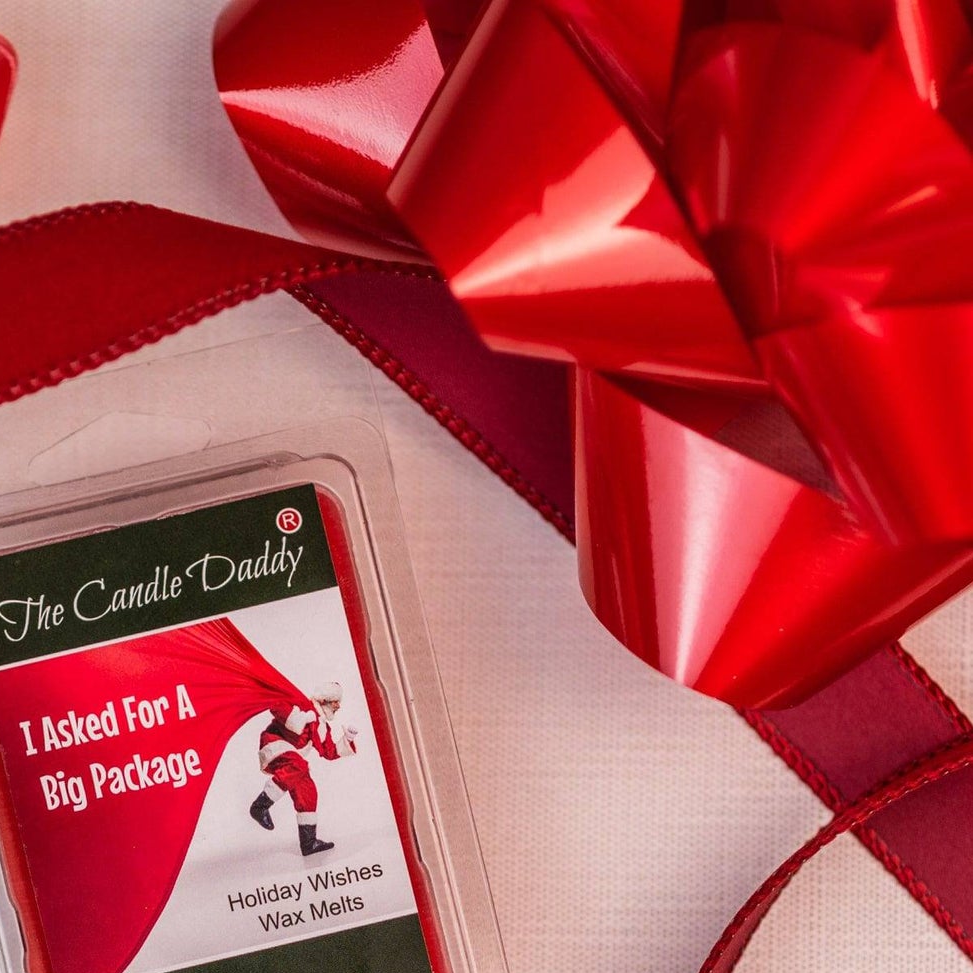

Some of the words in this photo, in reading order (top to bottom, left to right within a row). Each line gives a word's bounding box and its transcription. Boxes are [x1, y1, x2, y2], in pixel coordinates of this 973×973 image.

[73, 565, 182, 621] Candle
[185, 536, 304, 592] Daddy
[19, 719, 38, 756] I
[42, 708, 120, 752] Asked
[123, 694, 171, 734] For
[176, 684, 197, 721] A
[39, 771, 87, 812] Big
[92, 748, 203, 800] Package
[227, 881, 304, 911] Holiday
[307, 863, 384, 893] Wishes
[257, 909, 307, 933] Wax
[309, 893, 365, 922] Melts
